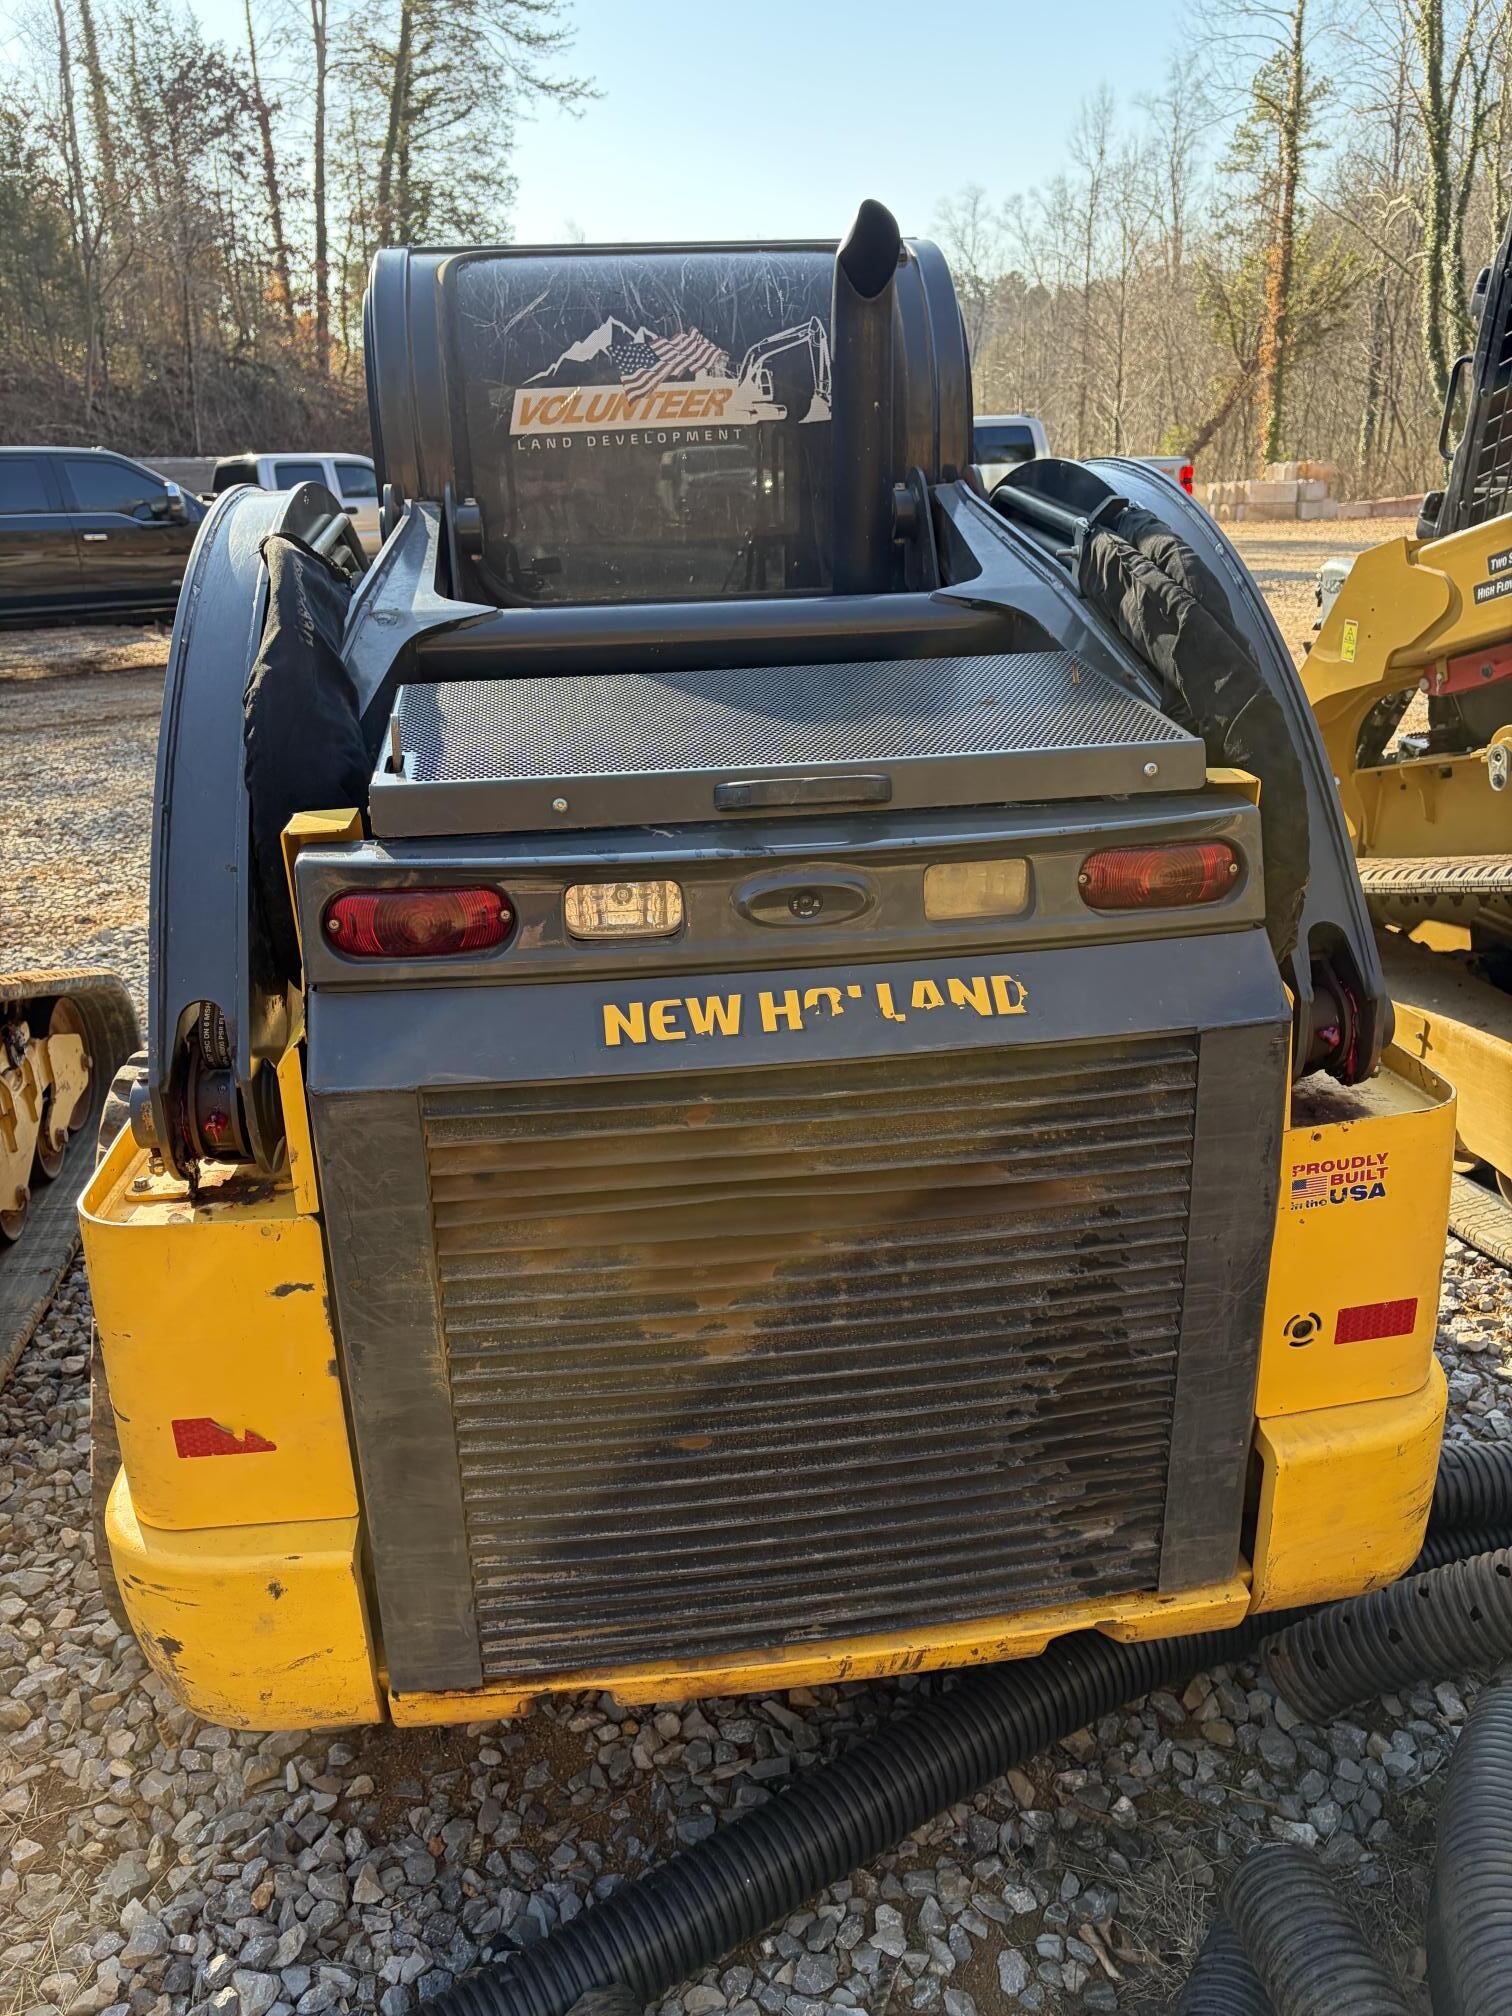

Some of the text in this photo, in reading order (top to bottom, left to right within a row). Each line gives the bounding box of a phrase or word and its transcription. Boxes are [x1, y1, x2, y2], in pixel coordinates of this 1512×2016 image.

[518, 388, 733, 427] VOLUNTEER
[517, 428, 743, 451] LAND DEVELOPMENT
[1491, 556, 1507, 570] TWO
[1478, 585, 1495, 600] HIGH
[603, 975, 1028, 1046] NEW HOLAND
[1292, 1152, 1389, 1177] PROUDLY
[1330, 1167, 1389, 1186] BUILT
[1305, 1199, 1328, 1209] the
[1329, 1182, 1386, 1204] USA
